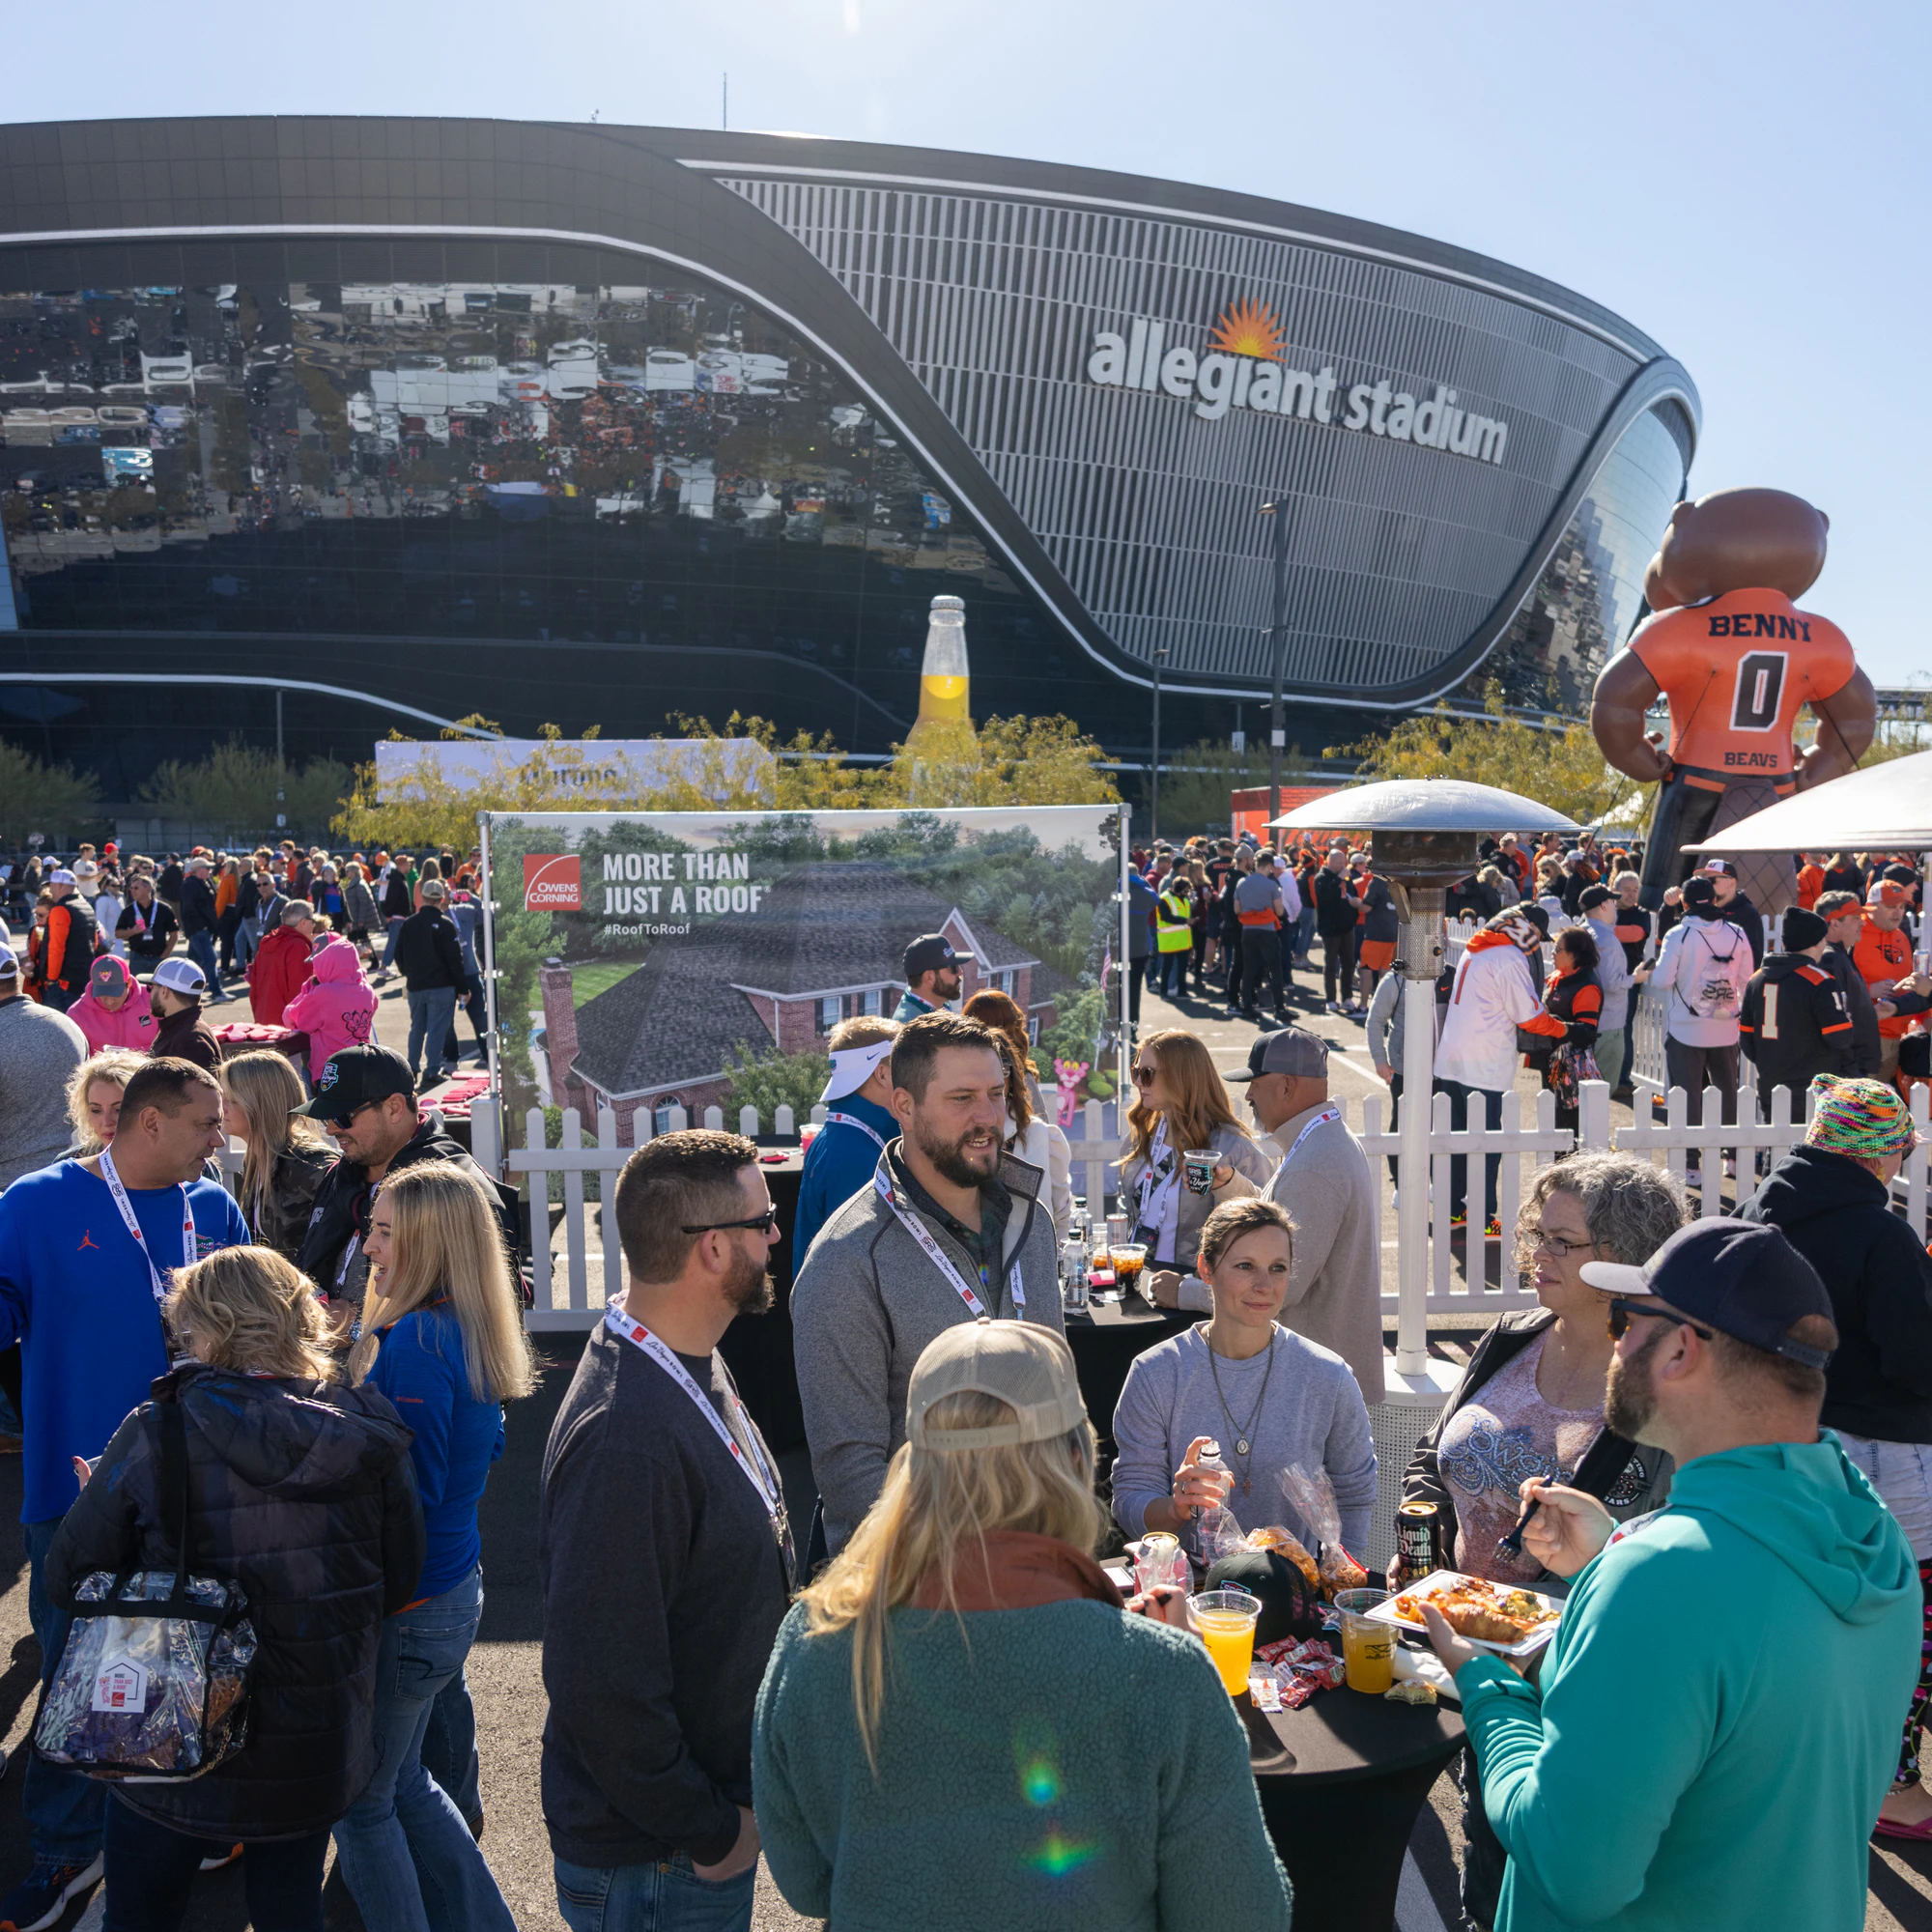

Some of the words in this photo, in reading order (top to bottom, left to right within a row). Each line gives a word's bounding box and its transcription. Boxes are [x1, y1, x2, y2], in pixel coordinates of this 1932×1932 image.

[1087, 318, 1337, 421] allegiant
[1343, 380, 1509, 466] stadium
[1708, 613, 1811, 642] BENNY
[1729, 649, 1789, 733] 0
[1723, 752, 1777, 768] BEAVS
[603, 853, 674, 881] MORE
[682, 853, 749, 880] THAN
[537, 882, 578, 893] OWENS
[528, 893, 579, 903] CORNING
[603, 887, 663, 915] JUST
[669, 886, 687, 914] A
[604, 923, 691, 935] #RoofToRoof
[1761, 982, 1778, 1040] 1
[922, 1236, 936, 1253] SRS
[669, 1361, 684, 1378] BOWL
[1397, 1522, 1432, 1546] Liquid
[1398, 1540, 1433, 1557] Death
